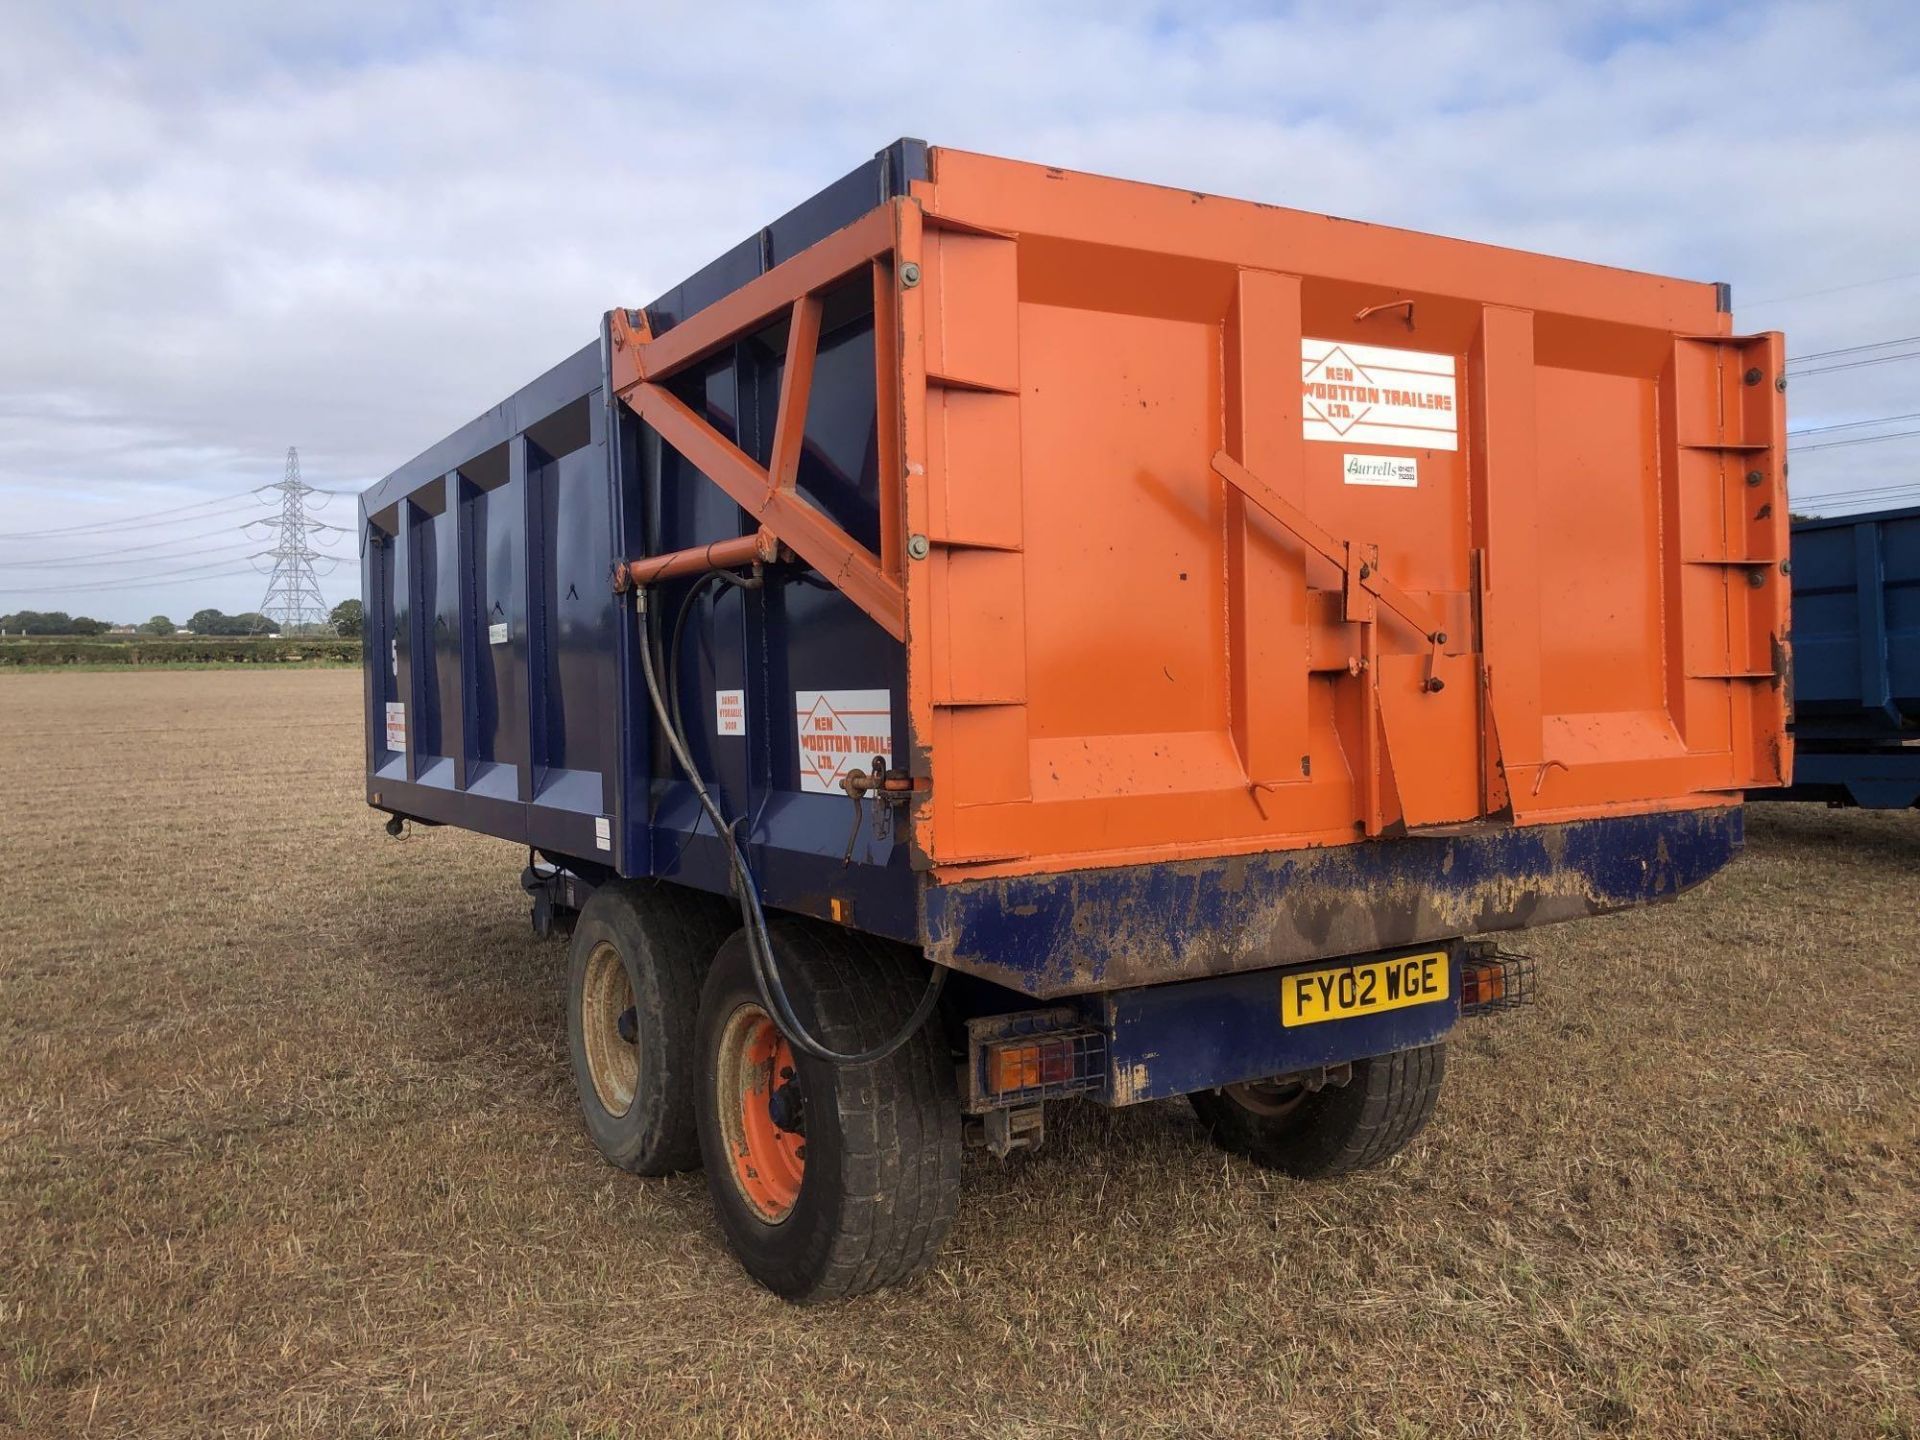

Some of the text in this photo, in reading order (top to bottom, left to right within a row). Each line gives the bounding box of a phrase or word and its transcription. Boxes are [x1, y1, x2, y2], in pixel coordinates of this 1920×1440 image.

[1325, 366, 1354, 381] KEN
[1302, 381, 1380, 404] WOOTTON
[1327, 404, 1354, 419] LTD.
[1347, 457, 1397, 476] Burrells
[814, 717, 833, 731] KEN
[801, 734, 852, 753] WOOTTON
[817, 755, 835, 769] LTD.
[1296, 957, 1438, 1017] FY02 WGE
